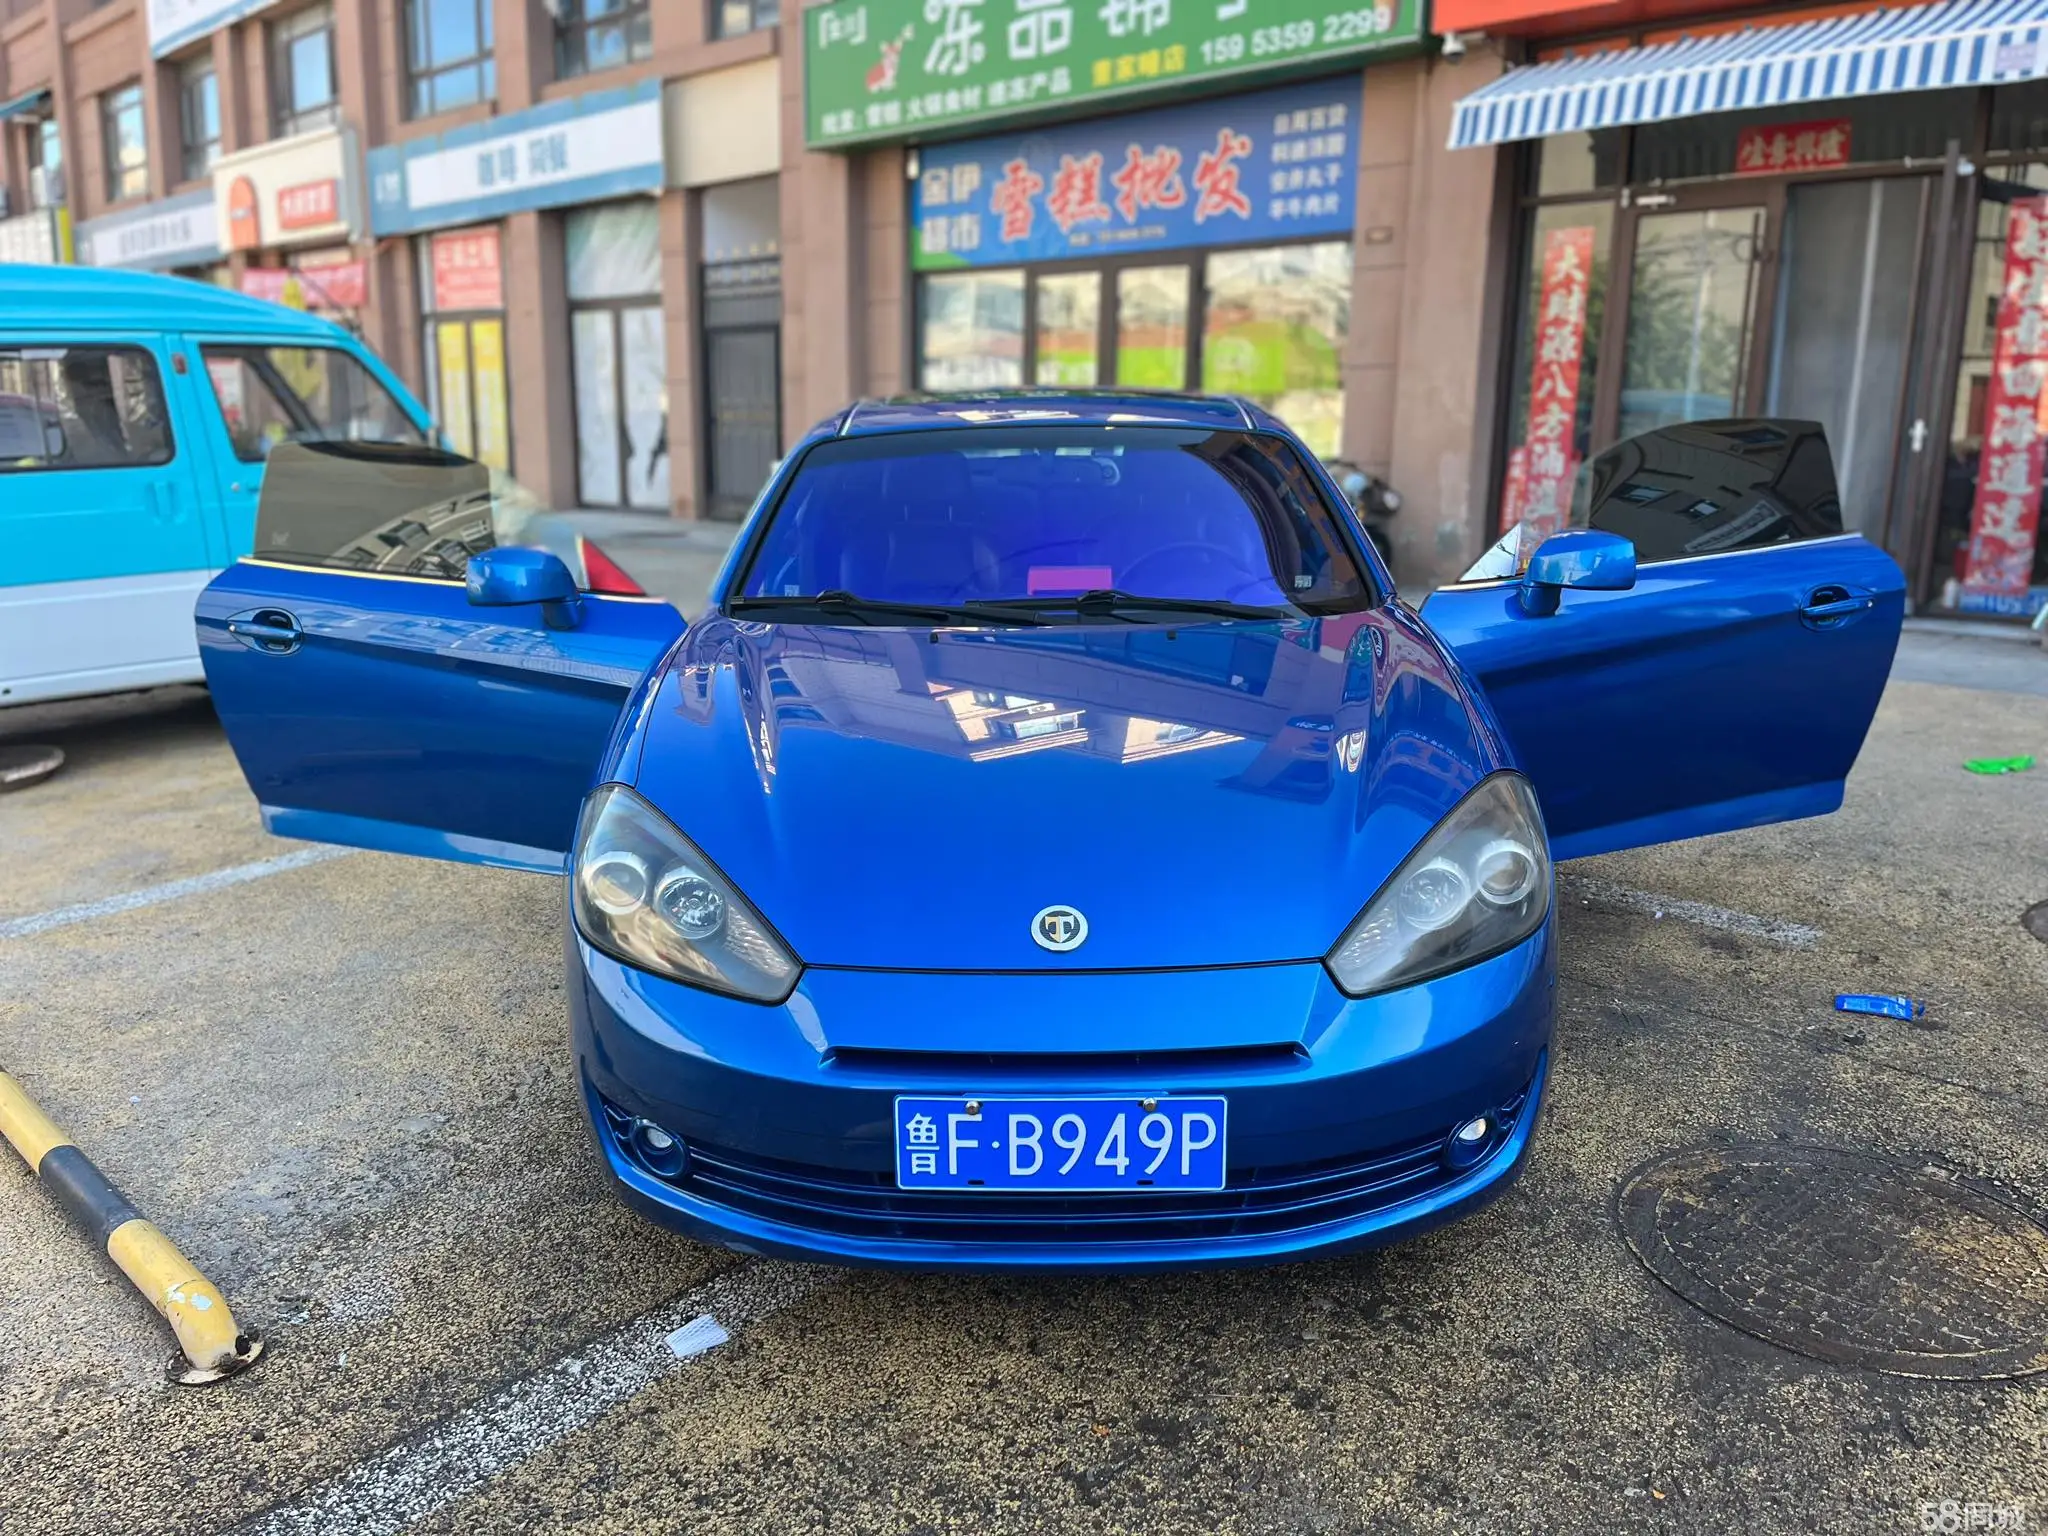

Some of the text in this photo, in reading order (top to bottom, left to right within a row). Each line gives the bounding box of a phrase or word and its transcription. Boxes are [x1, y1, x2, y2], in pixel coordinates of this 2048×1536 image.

[922, 0, 1247, 76] 冻品
[1200, 34, 1245, 65] 159
[1251, 20, 1316, 57] 5359
[1322, 5, 1393, 44] 2299
[989, 127, 1253, 243] 雪糕批发
[920, 212, 981, 255] 超市
